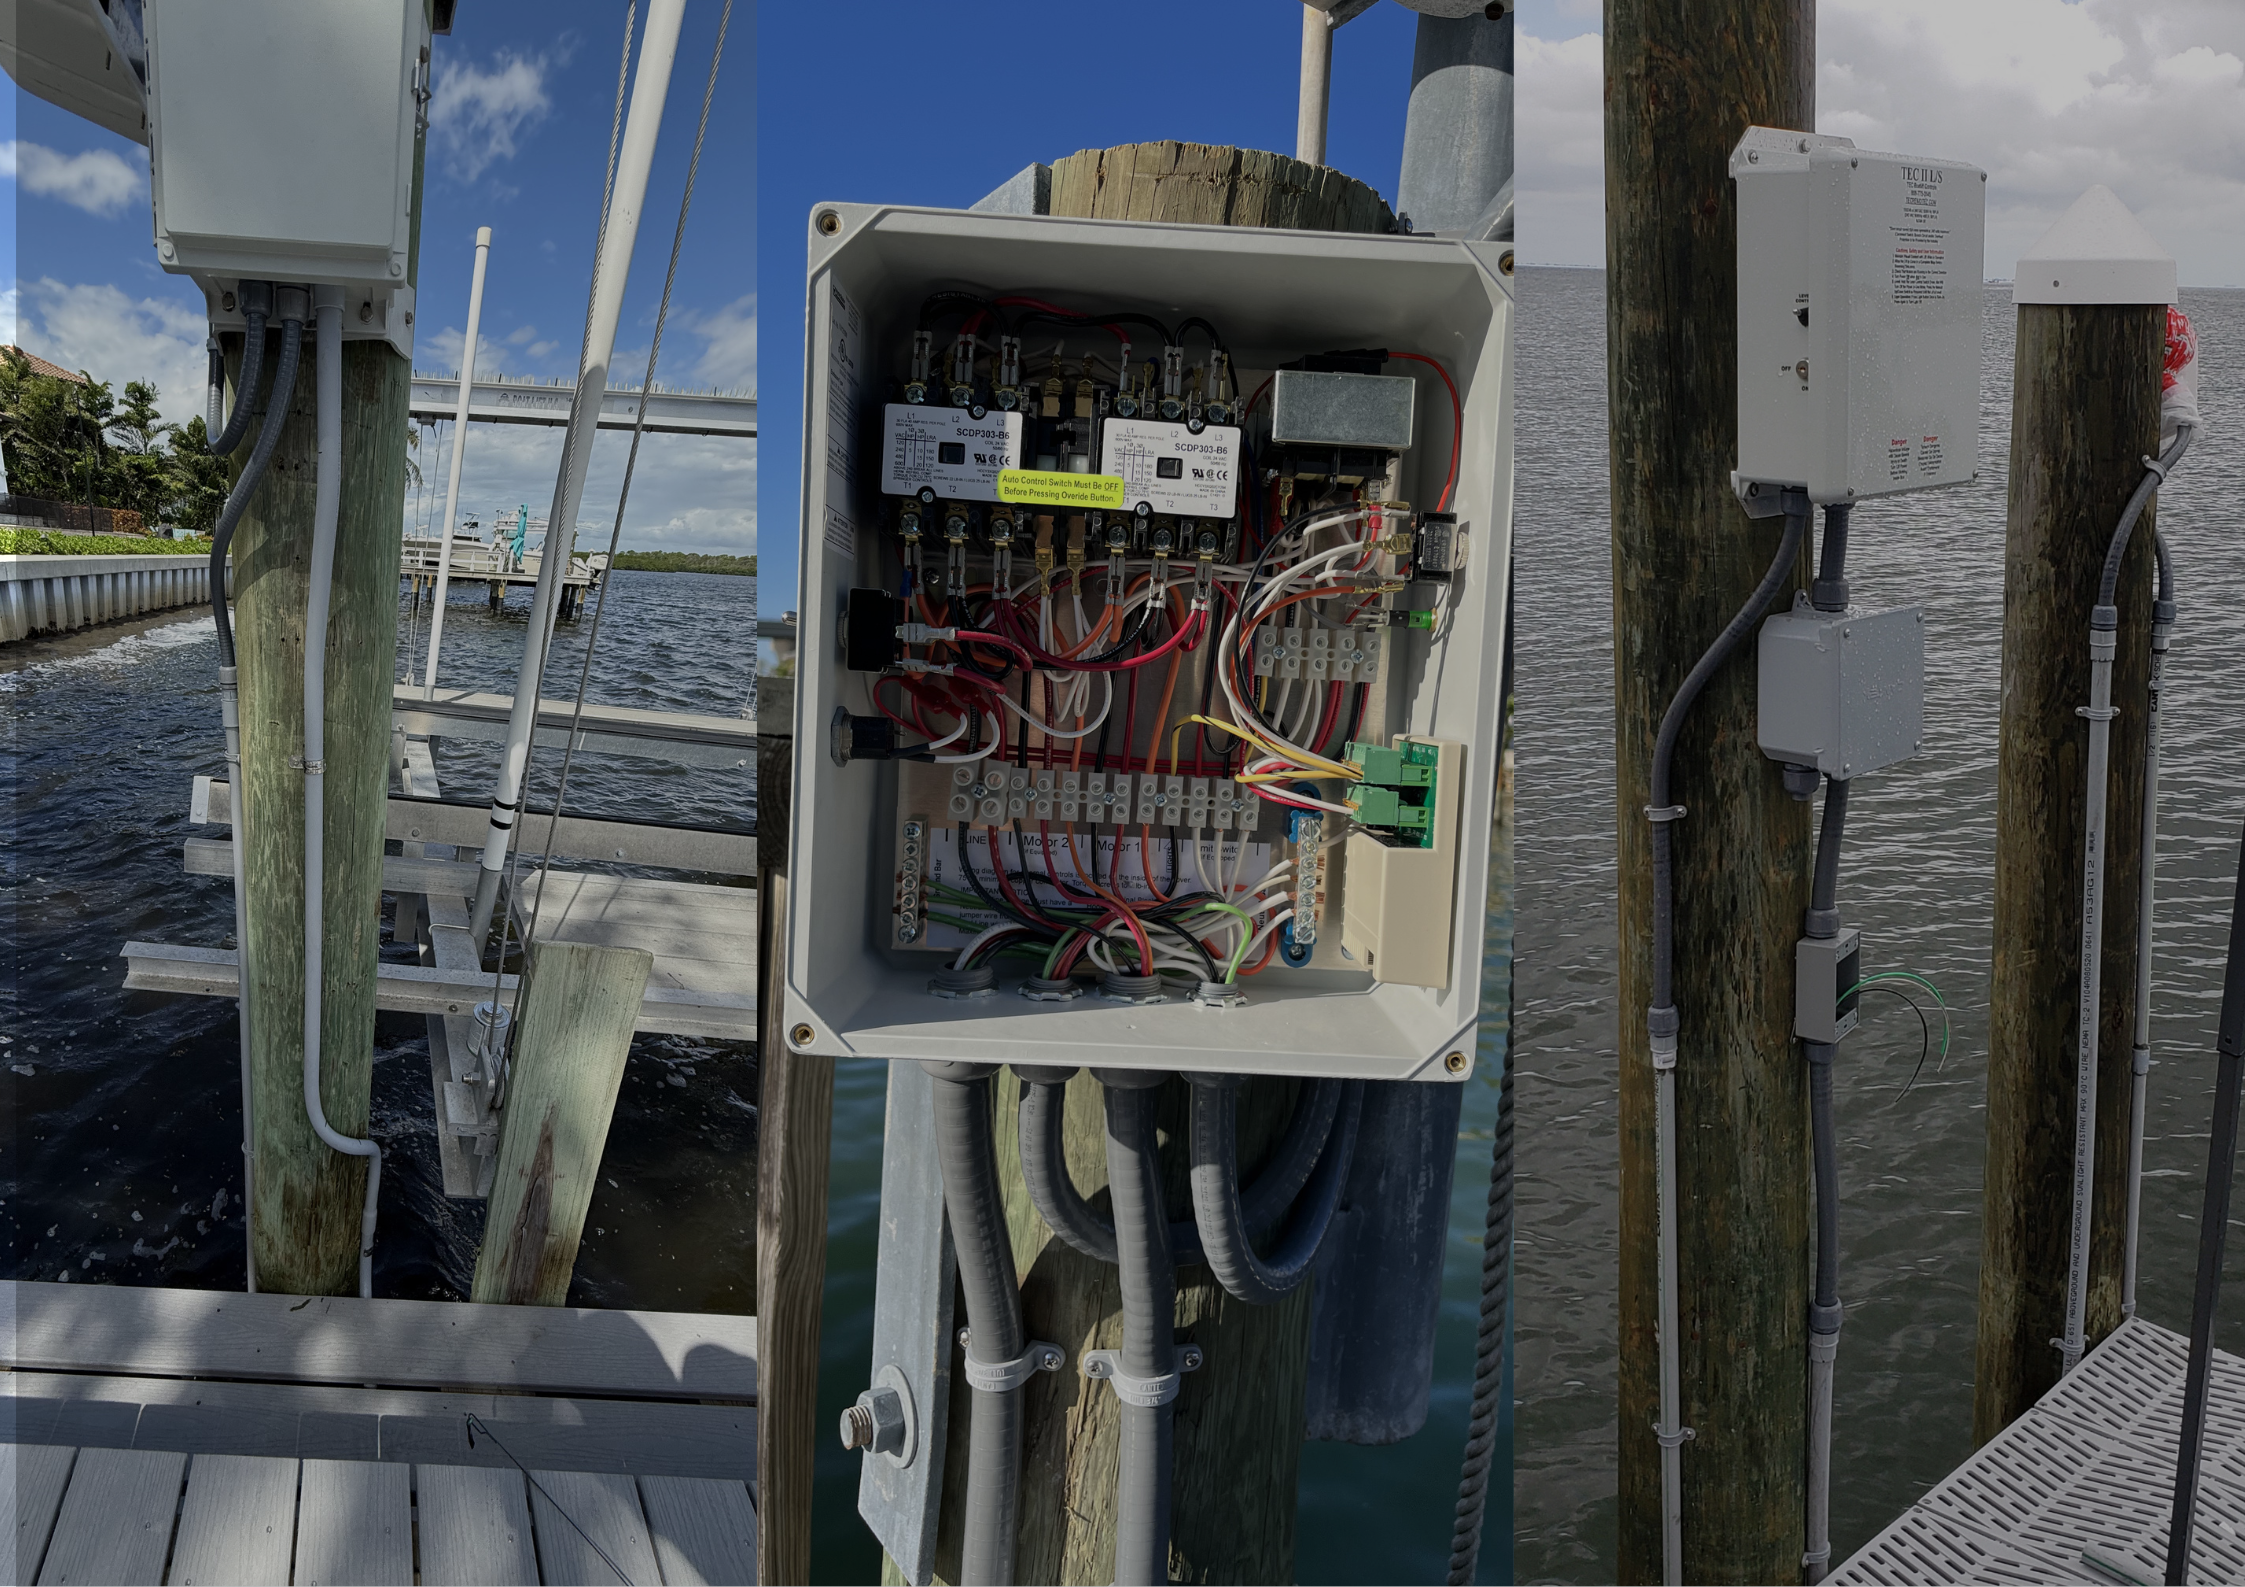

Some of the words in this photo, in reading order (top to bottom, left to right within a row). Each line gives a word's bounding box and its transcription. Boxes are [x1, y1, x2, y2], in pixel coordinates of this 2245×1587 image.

[1901, 167, 1919, 181] TEC
[1921, 168, 1928, 182] II
[1930, 170, 1942, 184] L/S
[956, 428, 1010, 440] SCDP303-B6
[1170, 430, 1178, 438] L2
[1175, 443, 1228, 454] SCDP303-B6
[1217, 470, 1228, 481] CE
[1002, 475, 1019, 484] Auto
[1021, 476, 1047, 485] Control
[1049, 479, 1072, 488] Switch
[1074, 481, 1091, 489] Must
[1093, 482, 1102, 490] Be
[1104, 483, 1118, 491] OFF
[1004, 487, 1027, 496] Before
[1029, 489, 1059, 500] Pressing
[1061, 491, 1088, 500] Overide
[1090, 493, 1115, 502] Button.
[1024, 836, 1058, 847] Moor
[1062, 837, 1069, 848] 2
[1097, 840, 1131, 851] Moor
[1135, 842, 1139, 852] 1
[934, 859, 942, 871] Bar
[2069, 1270, 2078, 1318] ABOVEGROUND
[2074, 1200, 2083, 1249] UNDERGROUND
[2086, 860, 2095, 925] A53AG12
